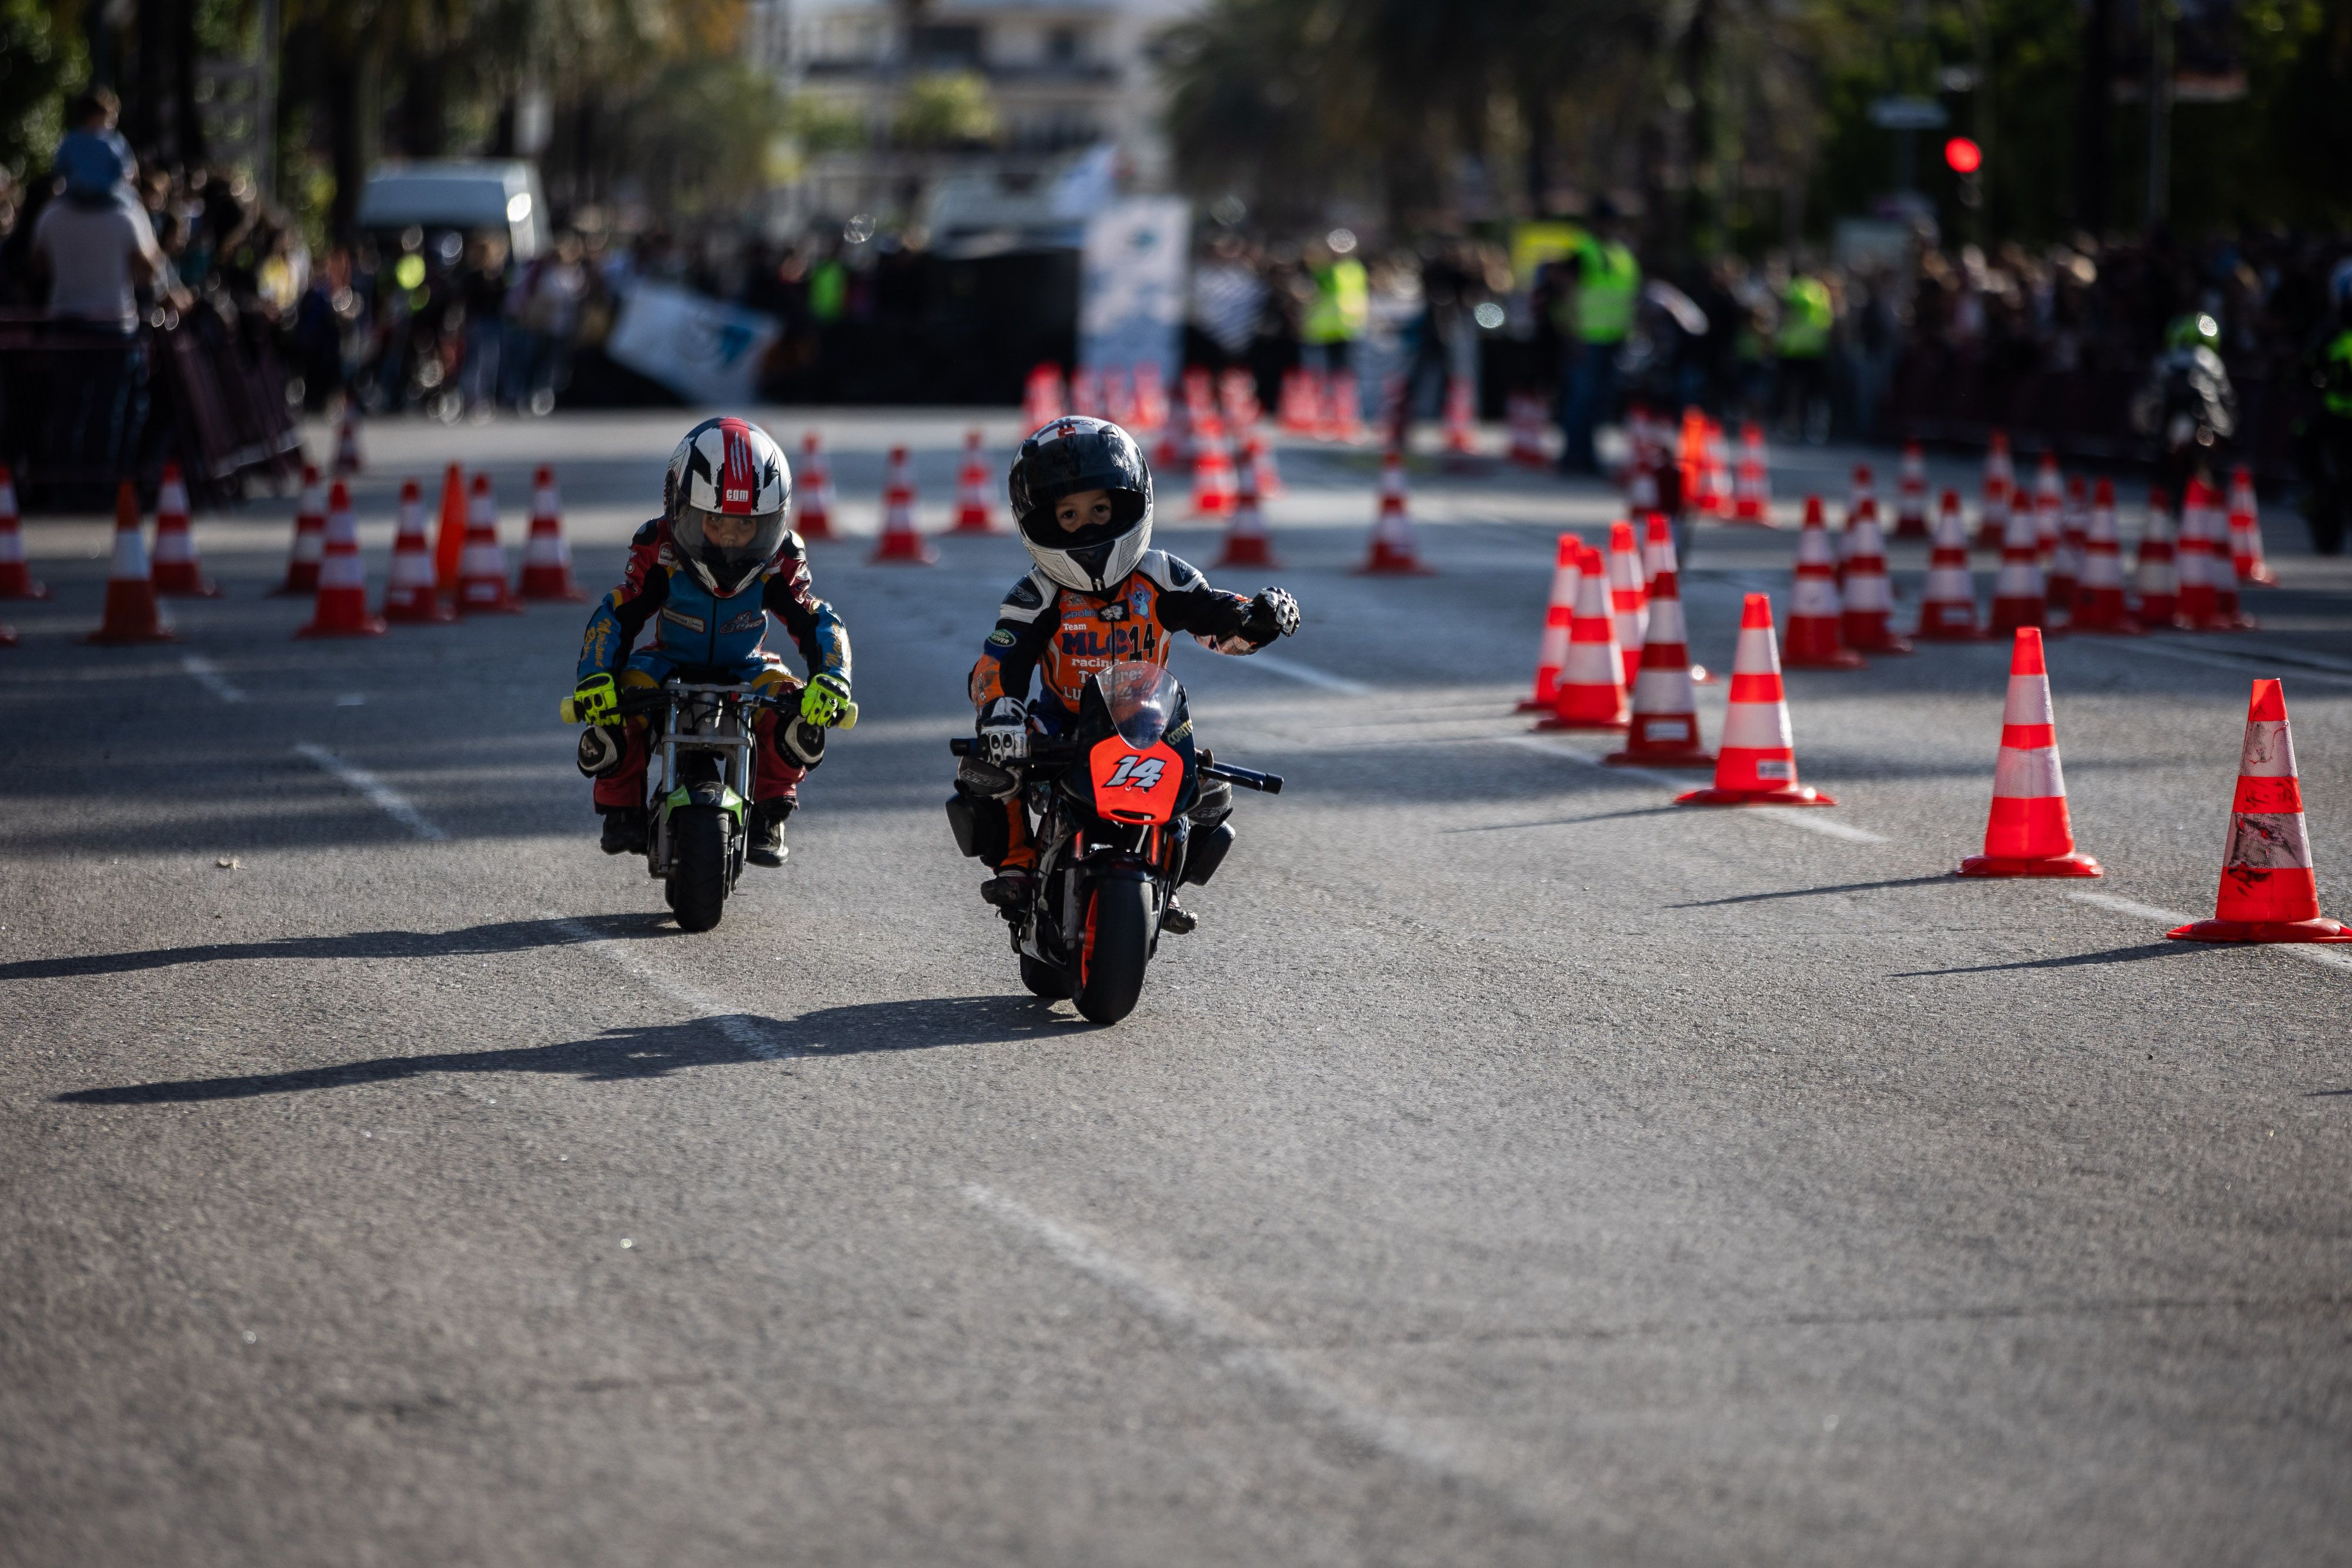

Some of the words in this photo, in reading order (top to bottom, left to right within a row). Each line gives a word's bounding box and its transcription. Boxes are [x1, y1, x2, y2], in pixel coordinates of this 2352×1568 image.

[726, 489, 748, 502] cgm
[991, 635, 1010, 645] ROVER
[1061, 629, 1128, 657] MLC
[1128, 623, 1156, 662] 14
[1102, 755, 1167, 788] 14
